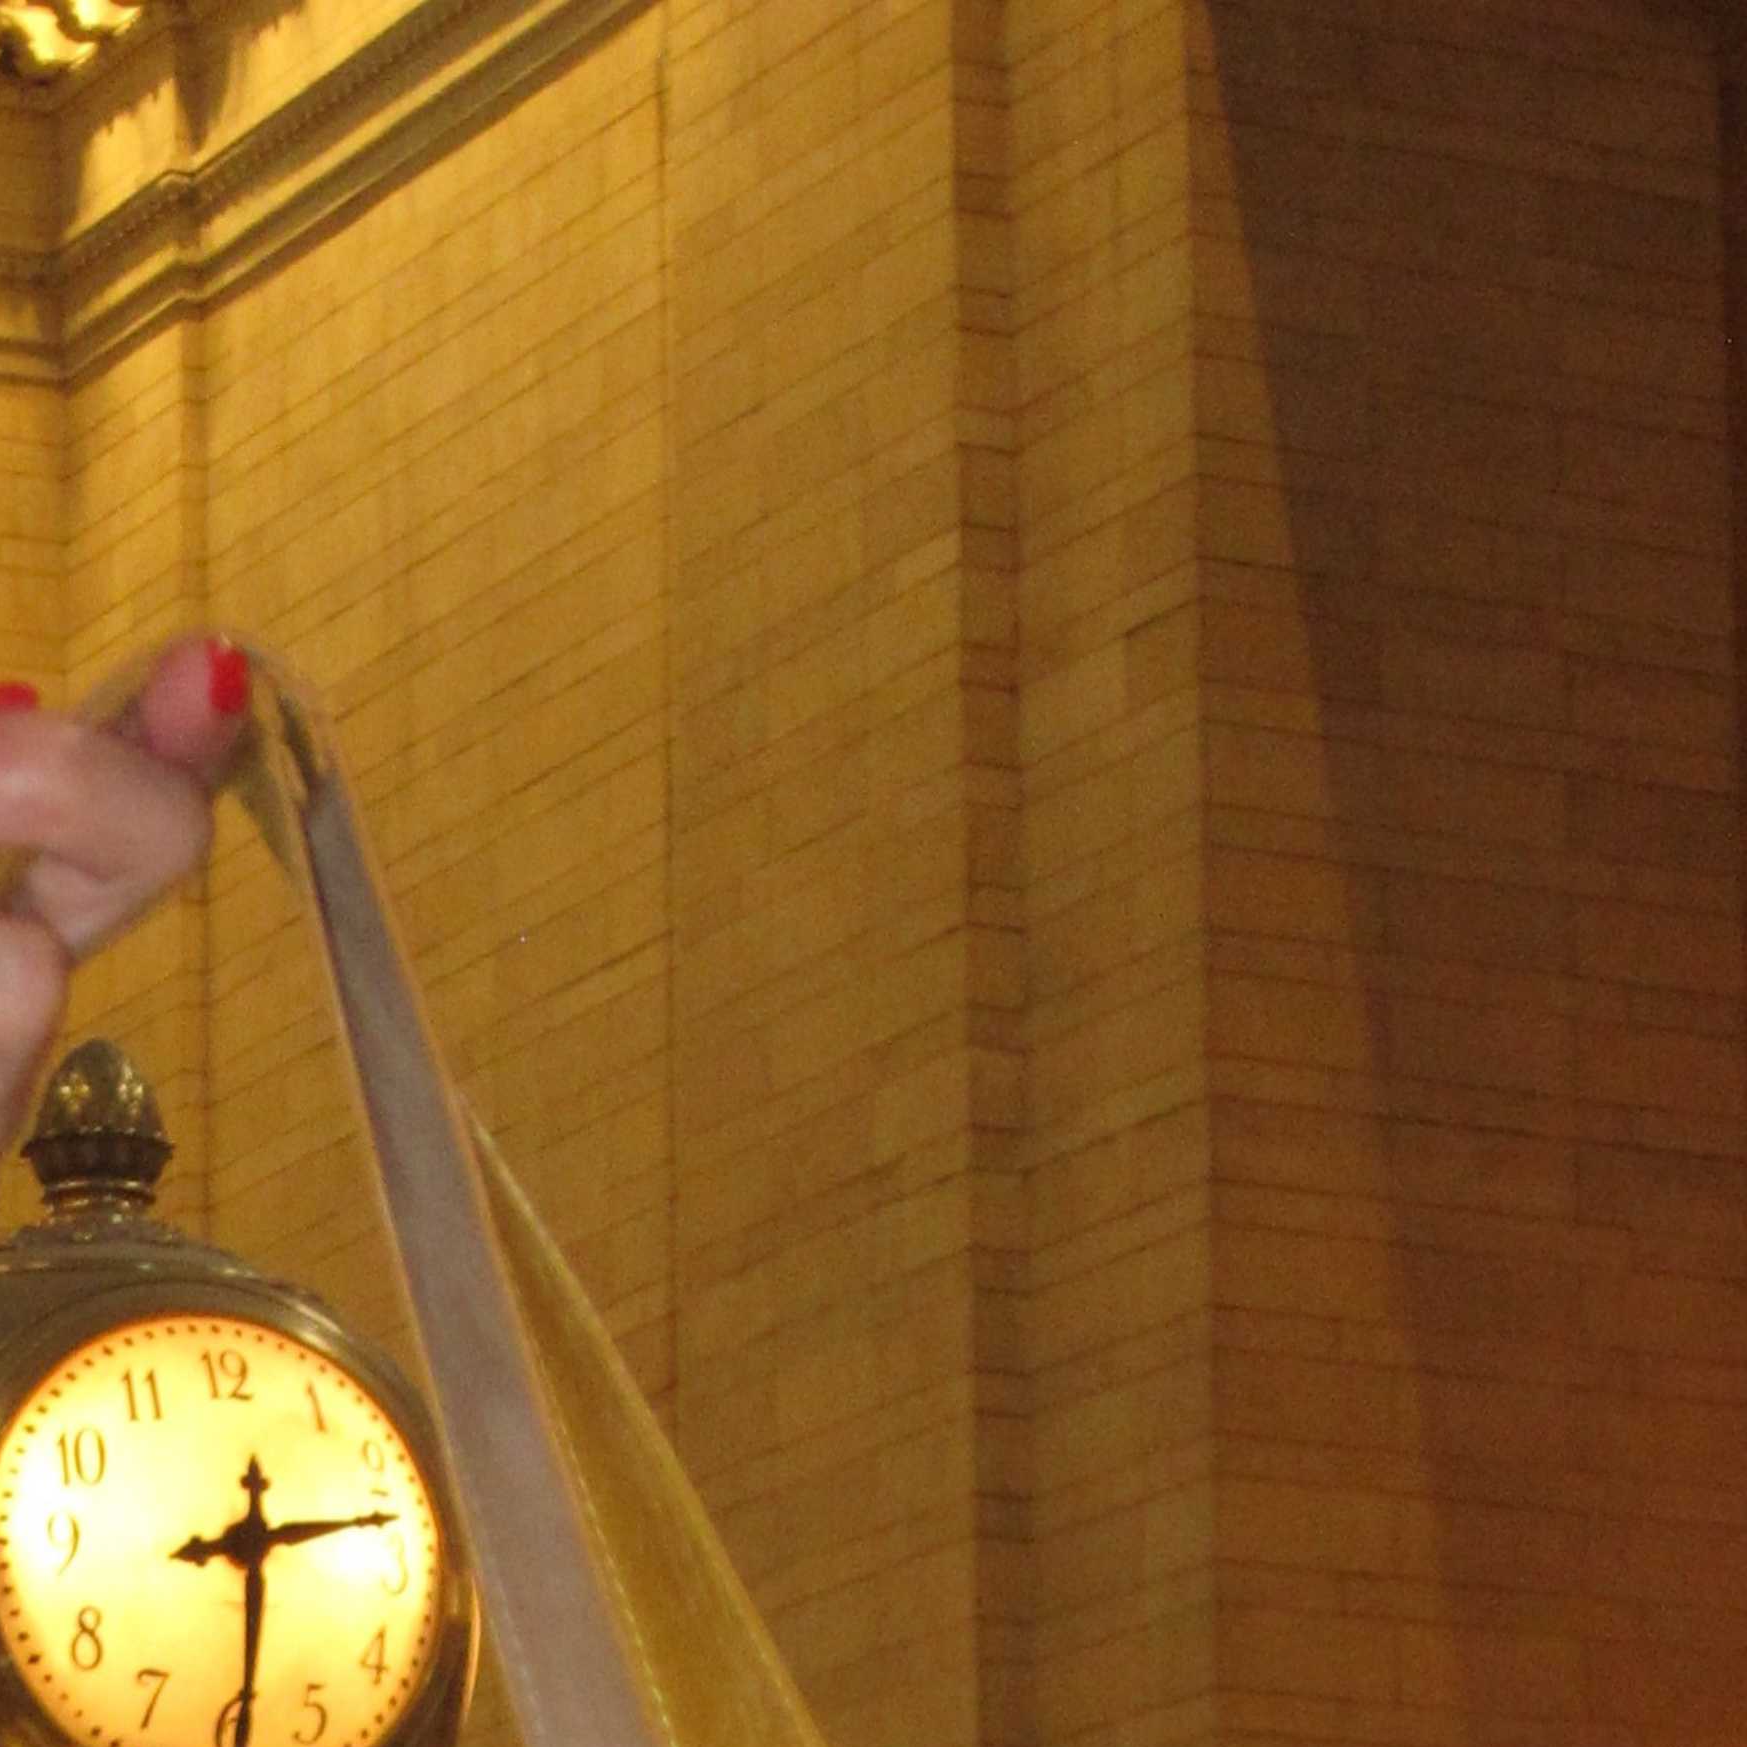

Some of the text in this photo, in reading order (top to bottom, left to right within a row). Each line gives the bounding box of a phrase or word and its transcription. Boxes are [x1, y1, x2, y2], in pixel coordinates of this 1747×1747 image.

[121, 1368, 162, 1421] 11
[202, 1349, 253, 1400] 12
[306, 1380, 328, 1433] 1
[56, 1427, 106, 1486] 10
[361, 1439, 389, 1497] 2
[46, 1511, 81, 1577] 9
[381, 1530, 409, 1595] 3
[70, 1605, 103, 1671] 8
[359, 1624, 389, 1686] 4
[135, 1668, 171, 1731] 7
[291, 1682, 328, 1746] 5
